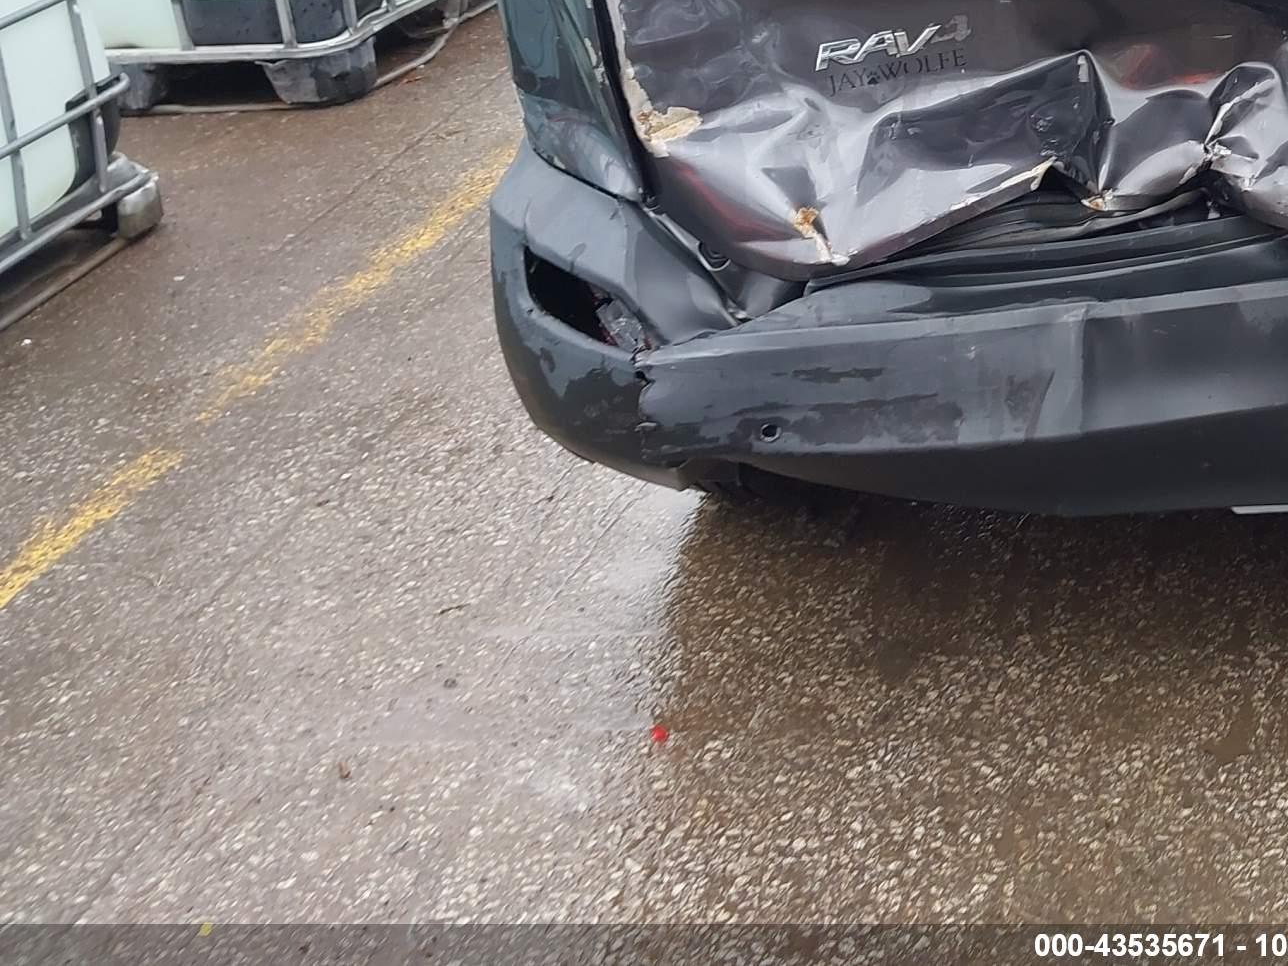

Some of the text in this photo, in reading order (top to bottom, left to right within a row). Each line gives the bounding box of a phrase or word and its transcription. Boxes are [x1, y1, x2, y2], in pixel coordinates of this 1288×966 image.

[815, 14, 971, 71] RAV4
[829, 48, 968, 97] JAY WOLFE
